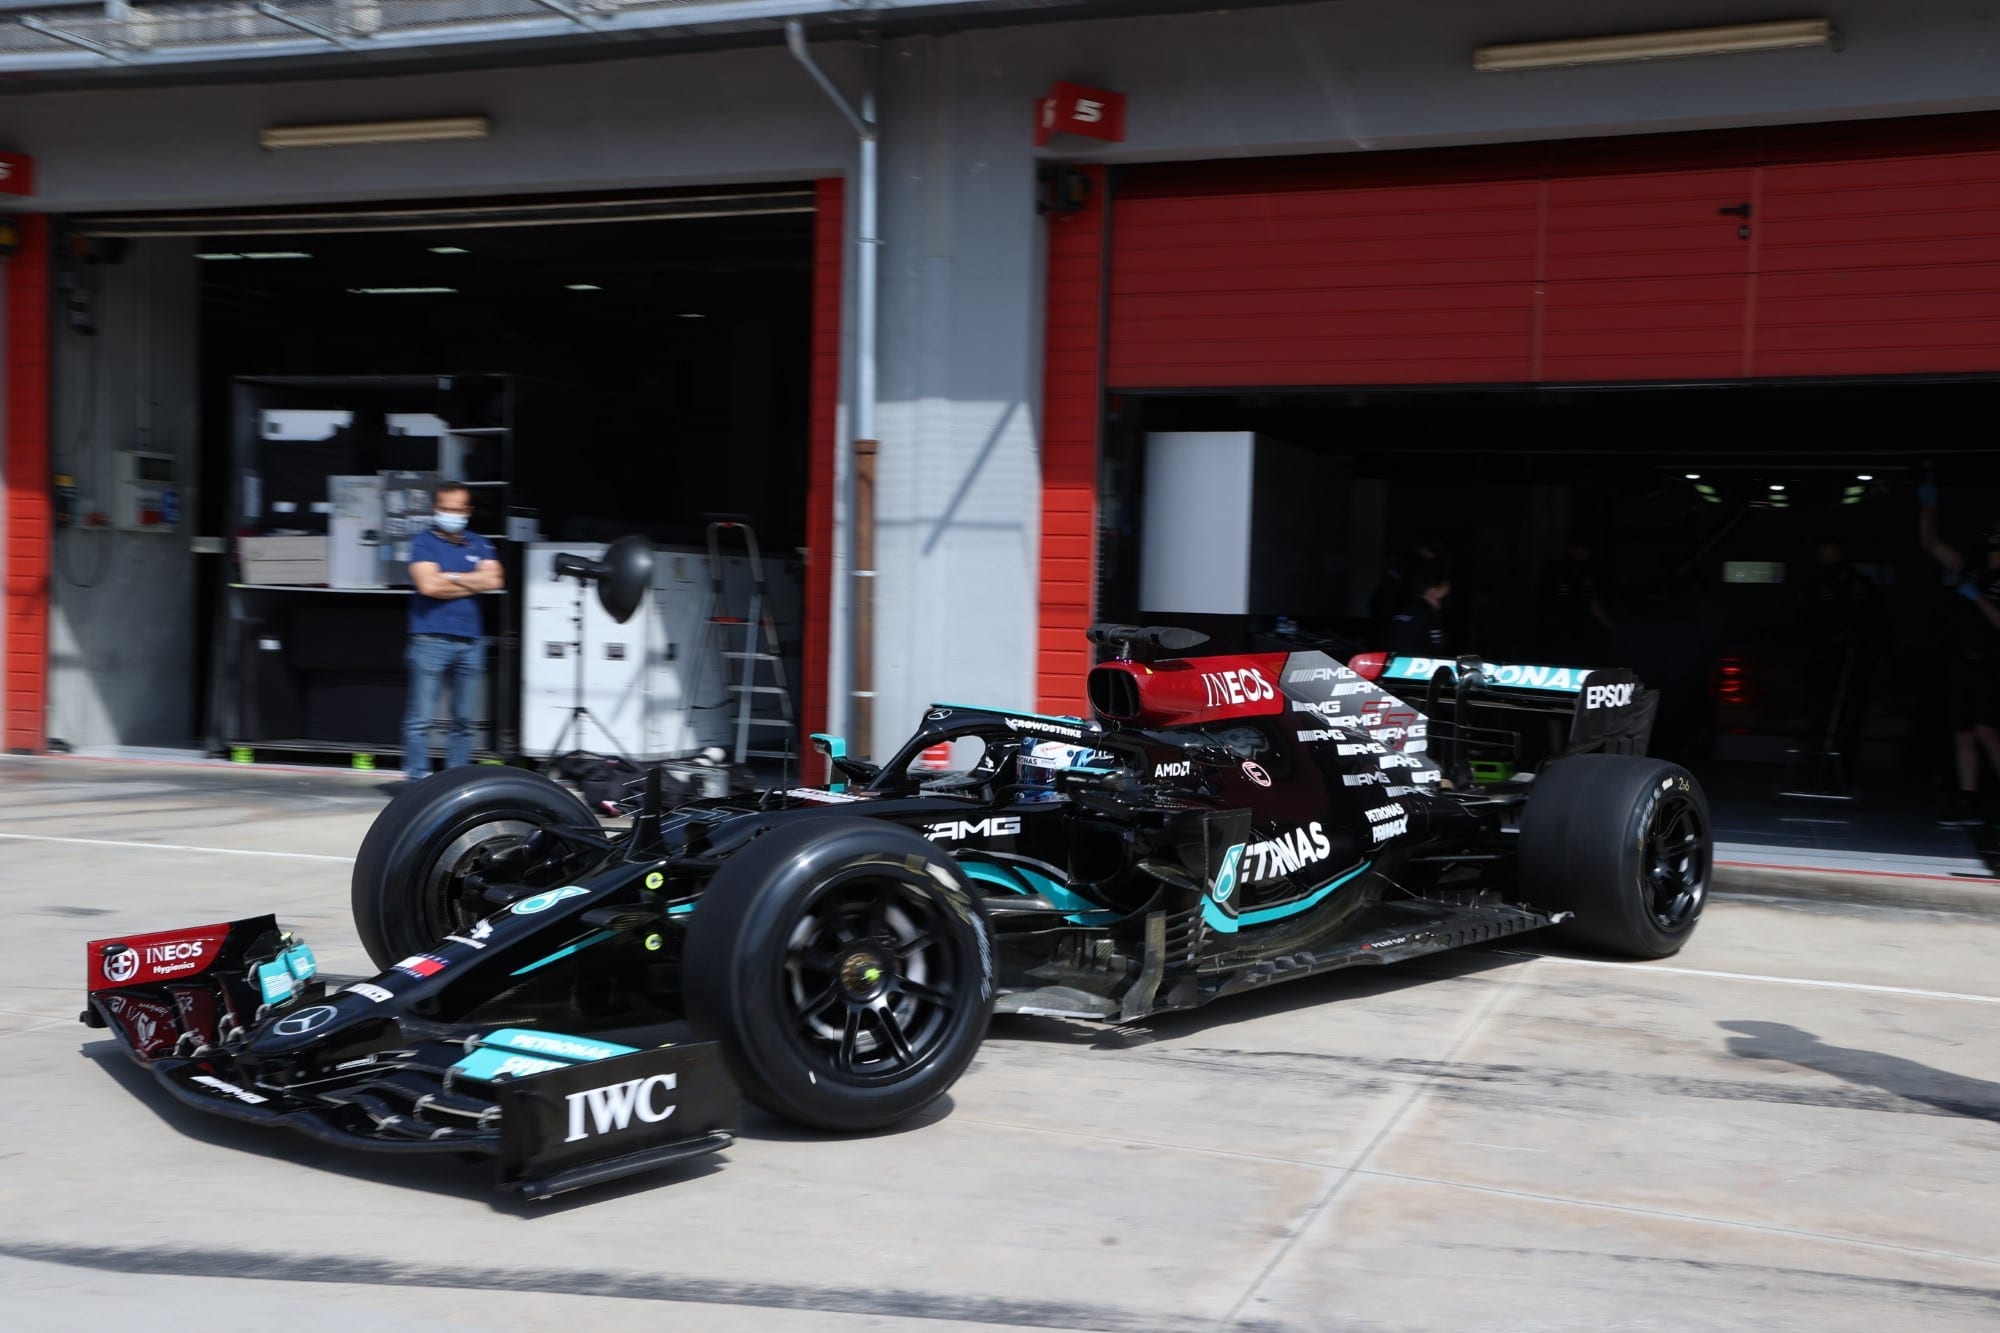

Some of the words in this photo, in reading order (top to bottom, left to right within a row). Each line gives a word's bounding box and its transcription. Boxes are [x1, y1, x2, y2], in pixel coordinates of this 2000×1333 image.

[1072, 98, 1105, 122] 5
[1310, 667, 1357, 681] AMG
[1201, 668, 1274, 707] INEOS
[1011, 718, 1082, 738] CROWDSTRIKE
[1155, 762, 1184, 778] AMD
[1364, 803, 1404, 823] PETRONAS
[927, 816, 1021, 841] AMG
[146, 941, 203, 965] INEOS
[153, 961, 196, 974] Hygienics
[564, 1073, 677, 1143] IWC
